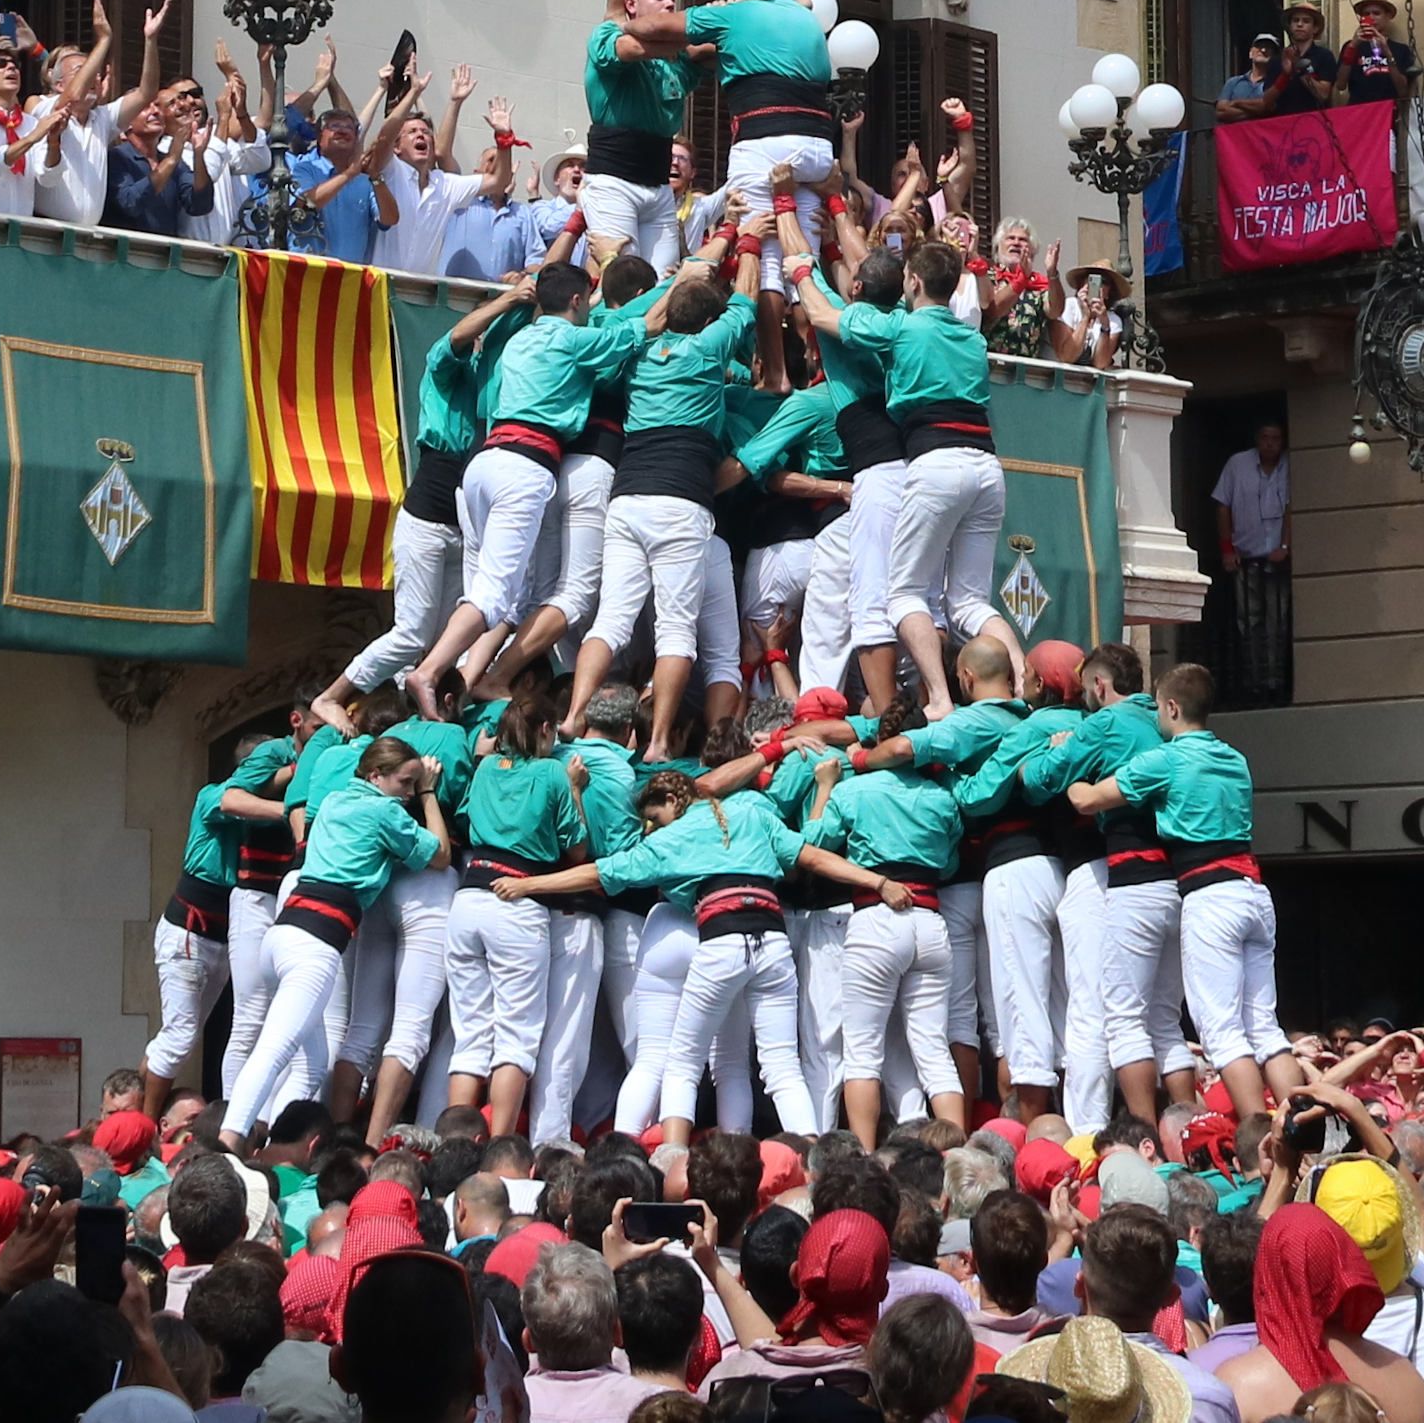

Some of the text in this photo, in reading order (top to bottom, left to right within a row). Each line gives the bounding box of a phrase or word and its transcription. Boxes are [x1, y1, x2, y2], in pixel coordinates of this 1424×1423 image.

[1257, 174, 1346, 202] VISCA LA
[1234, 188, 1367, 241] FESTA MAJOR
